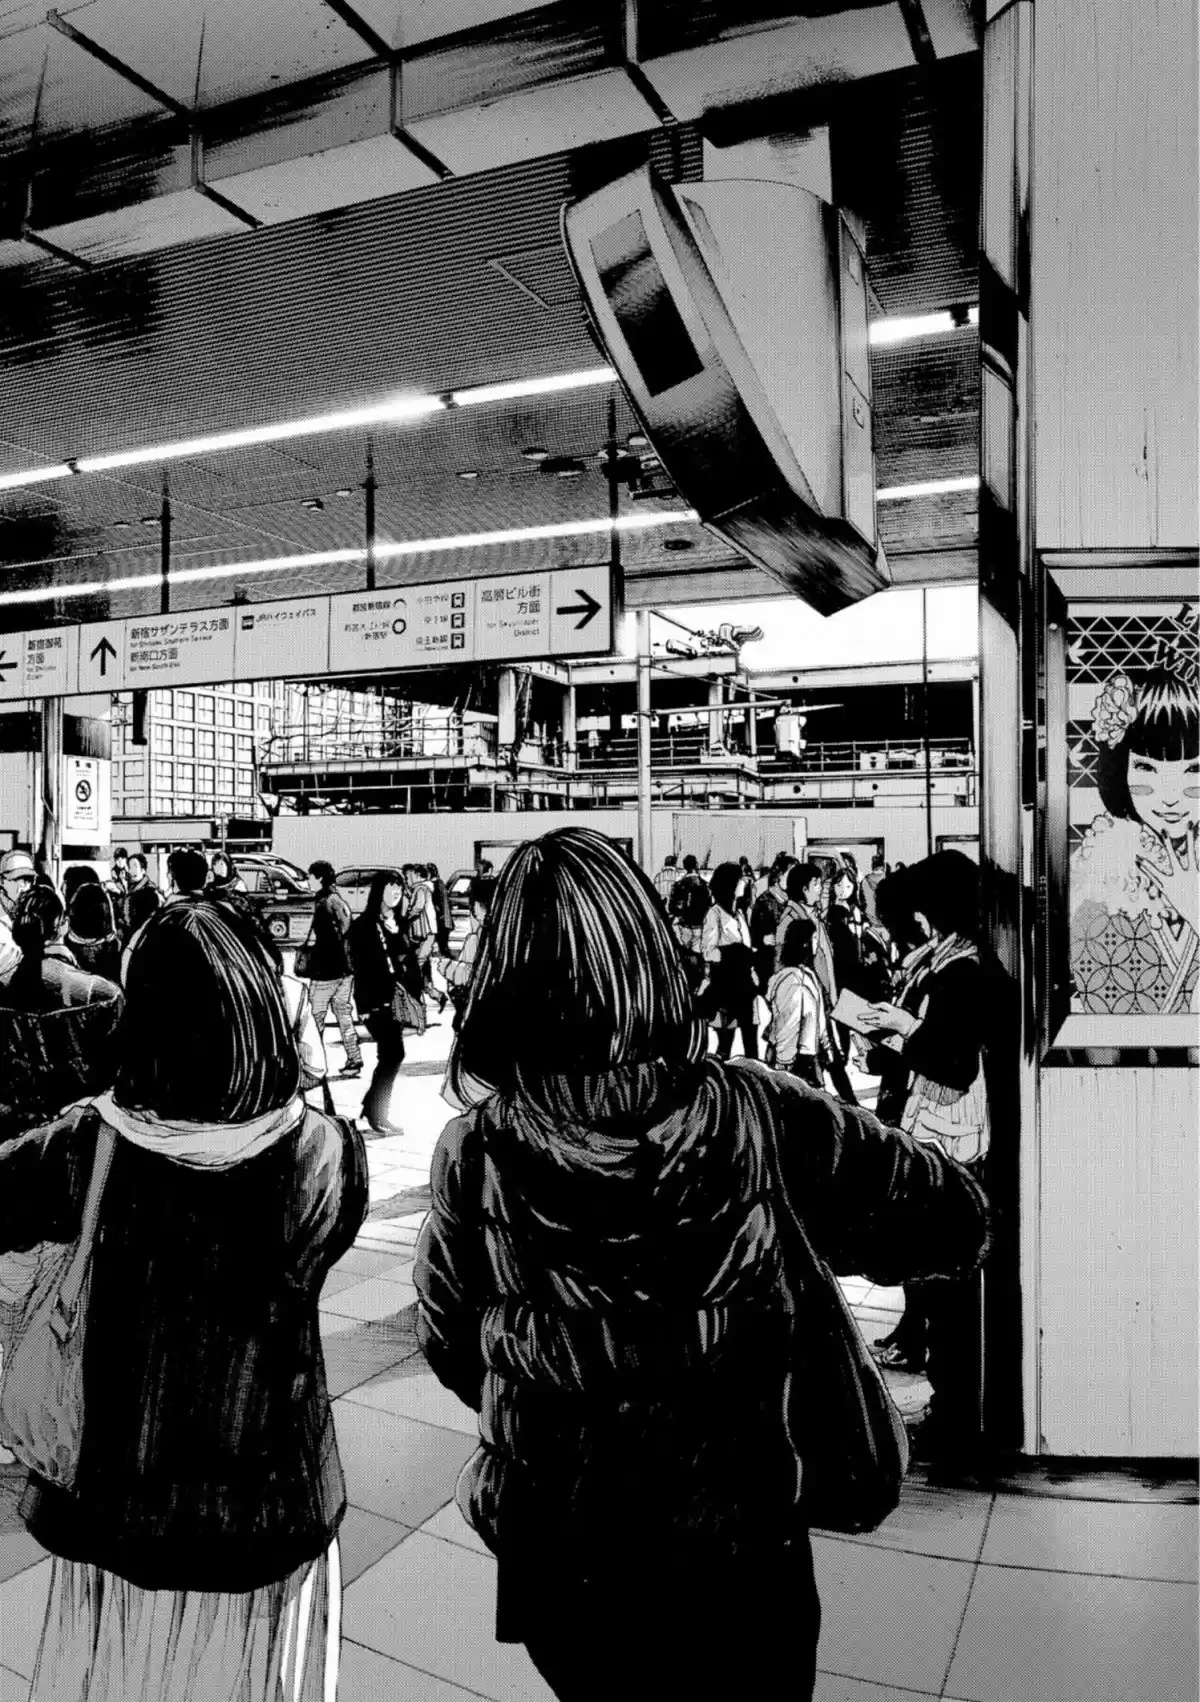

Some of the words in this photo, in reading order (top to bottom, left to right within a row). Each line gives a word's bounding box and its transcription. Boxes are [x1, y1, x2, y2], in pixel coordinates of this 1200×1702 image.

[481, 586, 540, 602] 高層ビル街
[516, 600, 540, 614] 方面
[131, 618, 229, 640] 新宿サザンテラス方面
[27, 652, 44, 665] 方面
